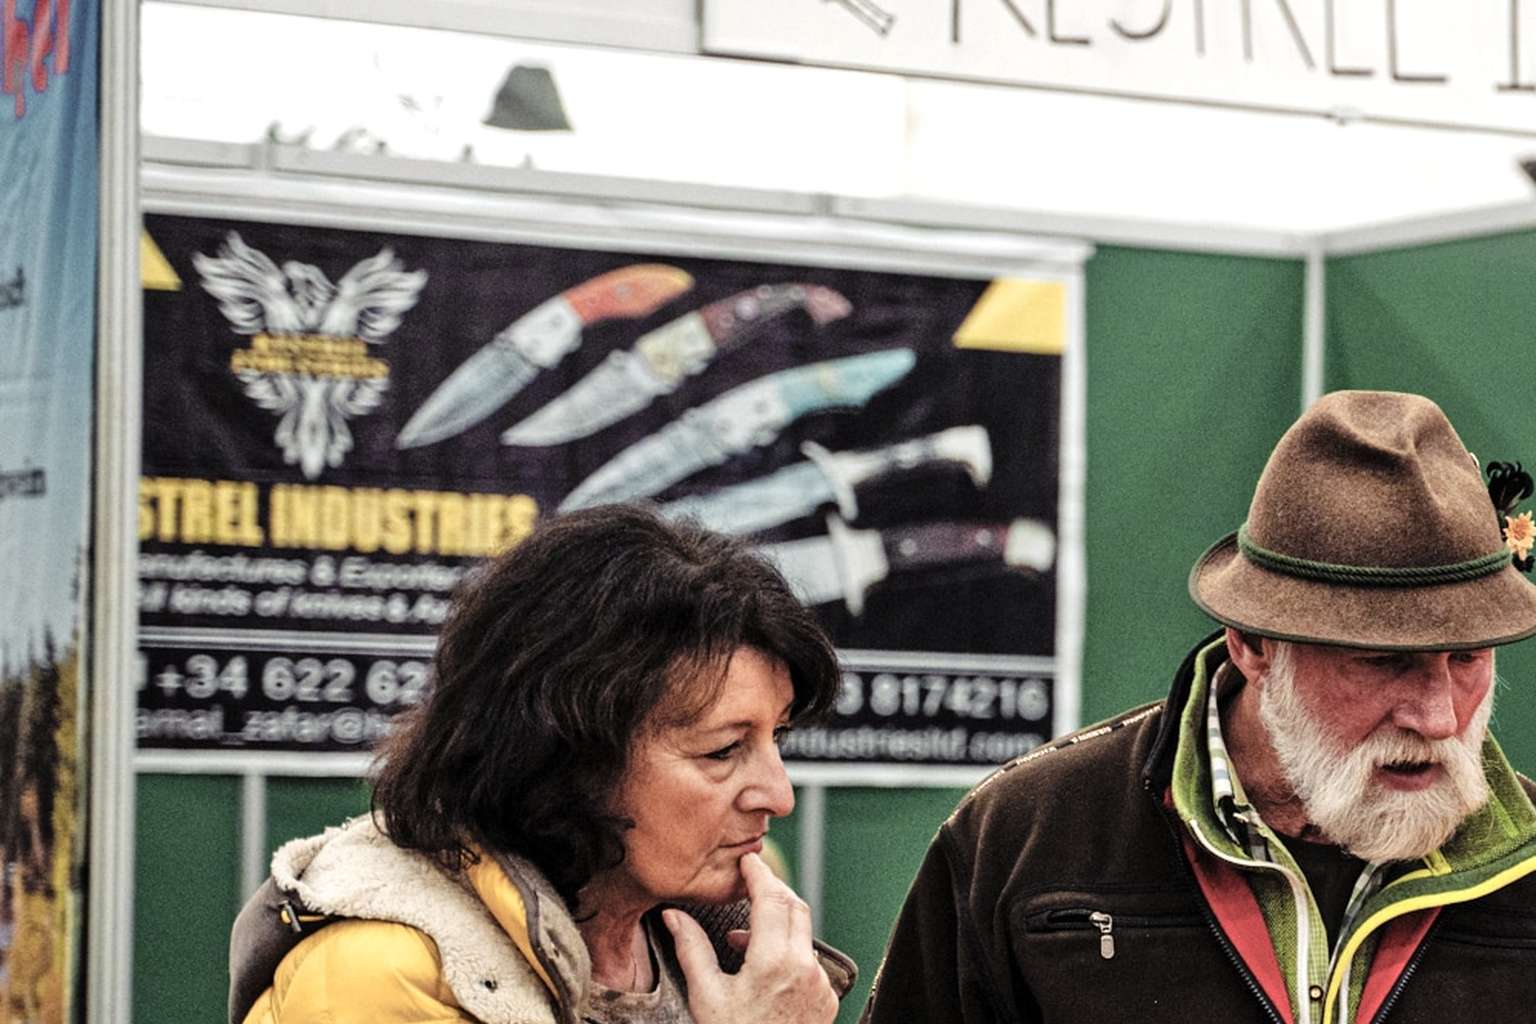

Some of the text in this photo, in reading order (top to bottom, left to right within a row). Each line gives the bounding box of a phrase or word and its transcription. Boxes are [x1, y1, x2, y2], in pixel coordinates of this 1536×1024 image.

[270, 482, 538, 558] INDUSTRIES
[310, 554, 337, 587] &
[155, 653, 248, 700] +34
[262, 656, 355, 702] 622
